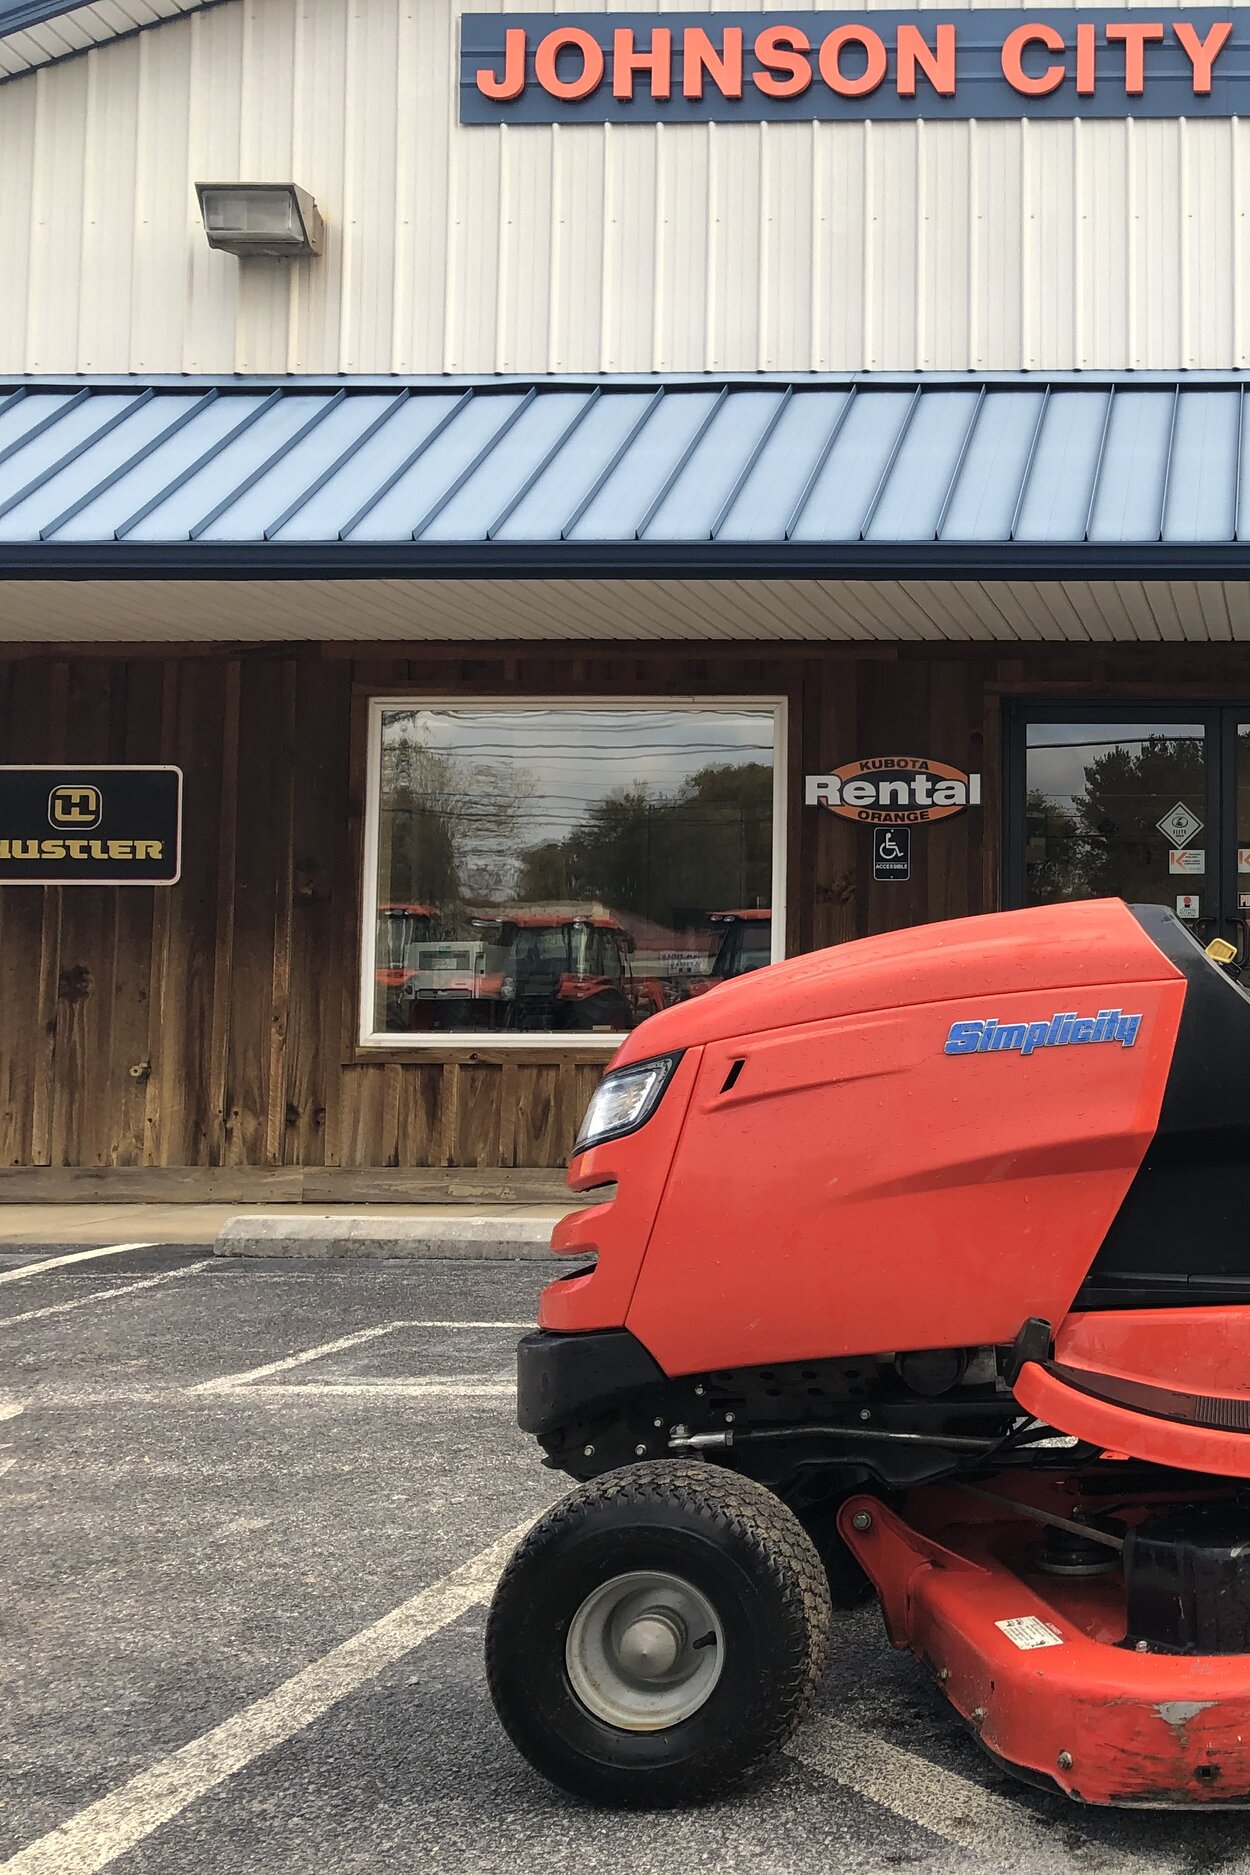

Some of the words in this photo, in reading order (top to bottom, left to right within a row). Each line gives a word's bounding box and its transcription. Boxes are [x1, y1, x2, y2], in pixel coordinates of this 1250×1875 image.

[476, 24, 956, 100] JOHNSON
[1000, 22, 1234, 96] CITY
[858, 758, 930, 772] KUBOTA
[805, 773, 981, 806] Rental
[857, 810, 931, 823] ORANGE
[944, 1008, 1143, 1055] Simplicity
